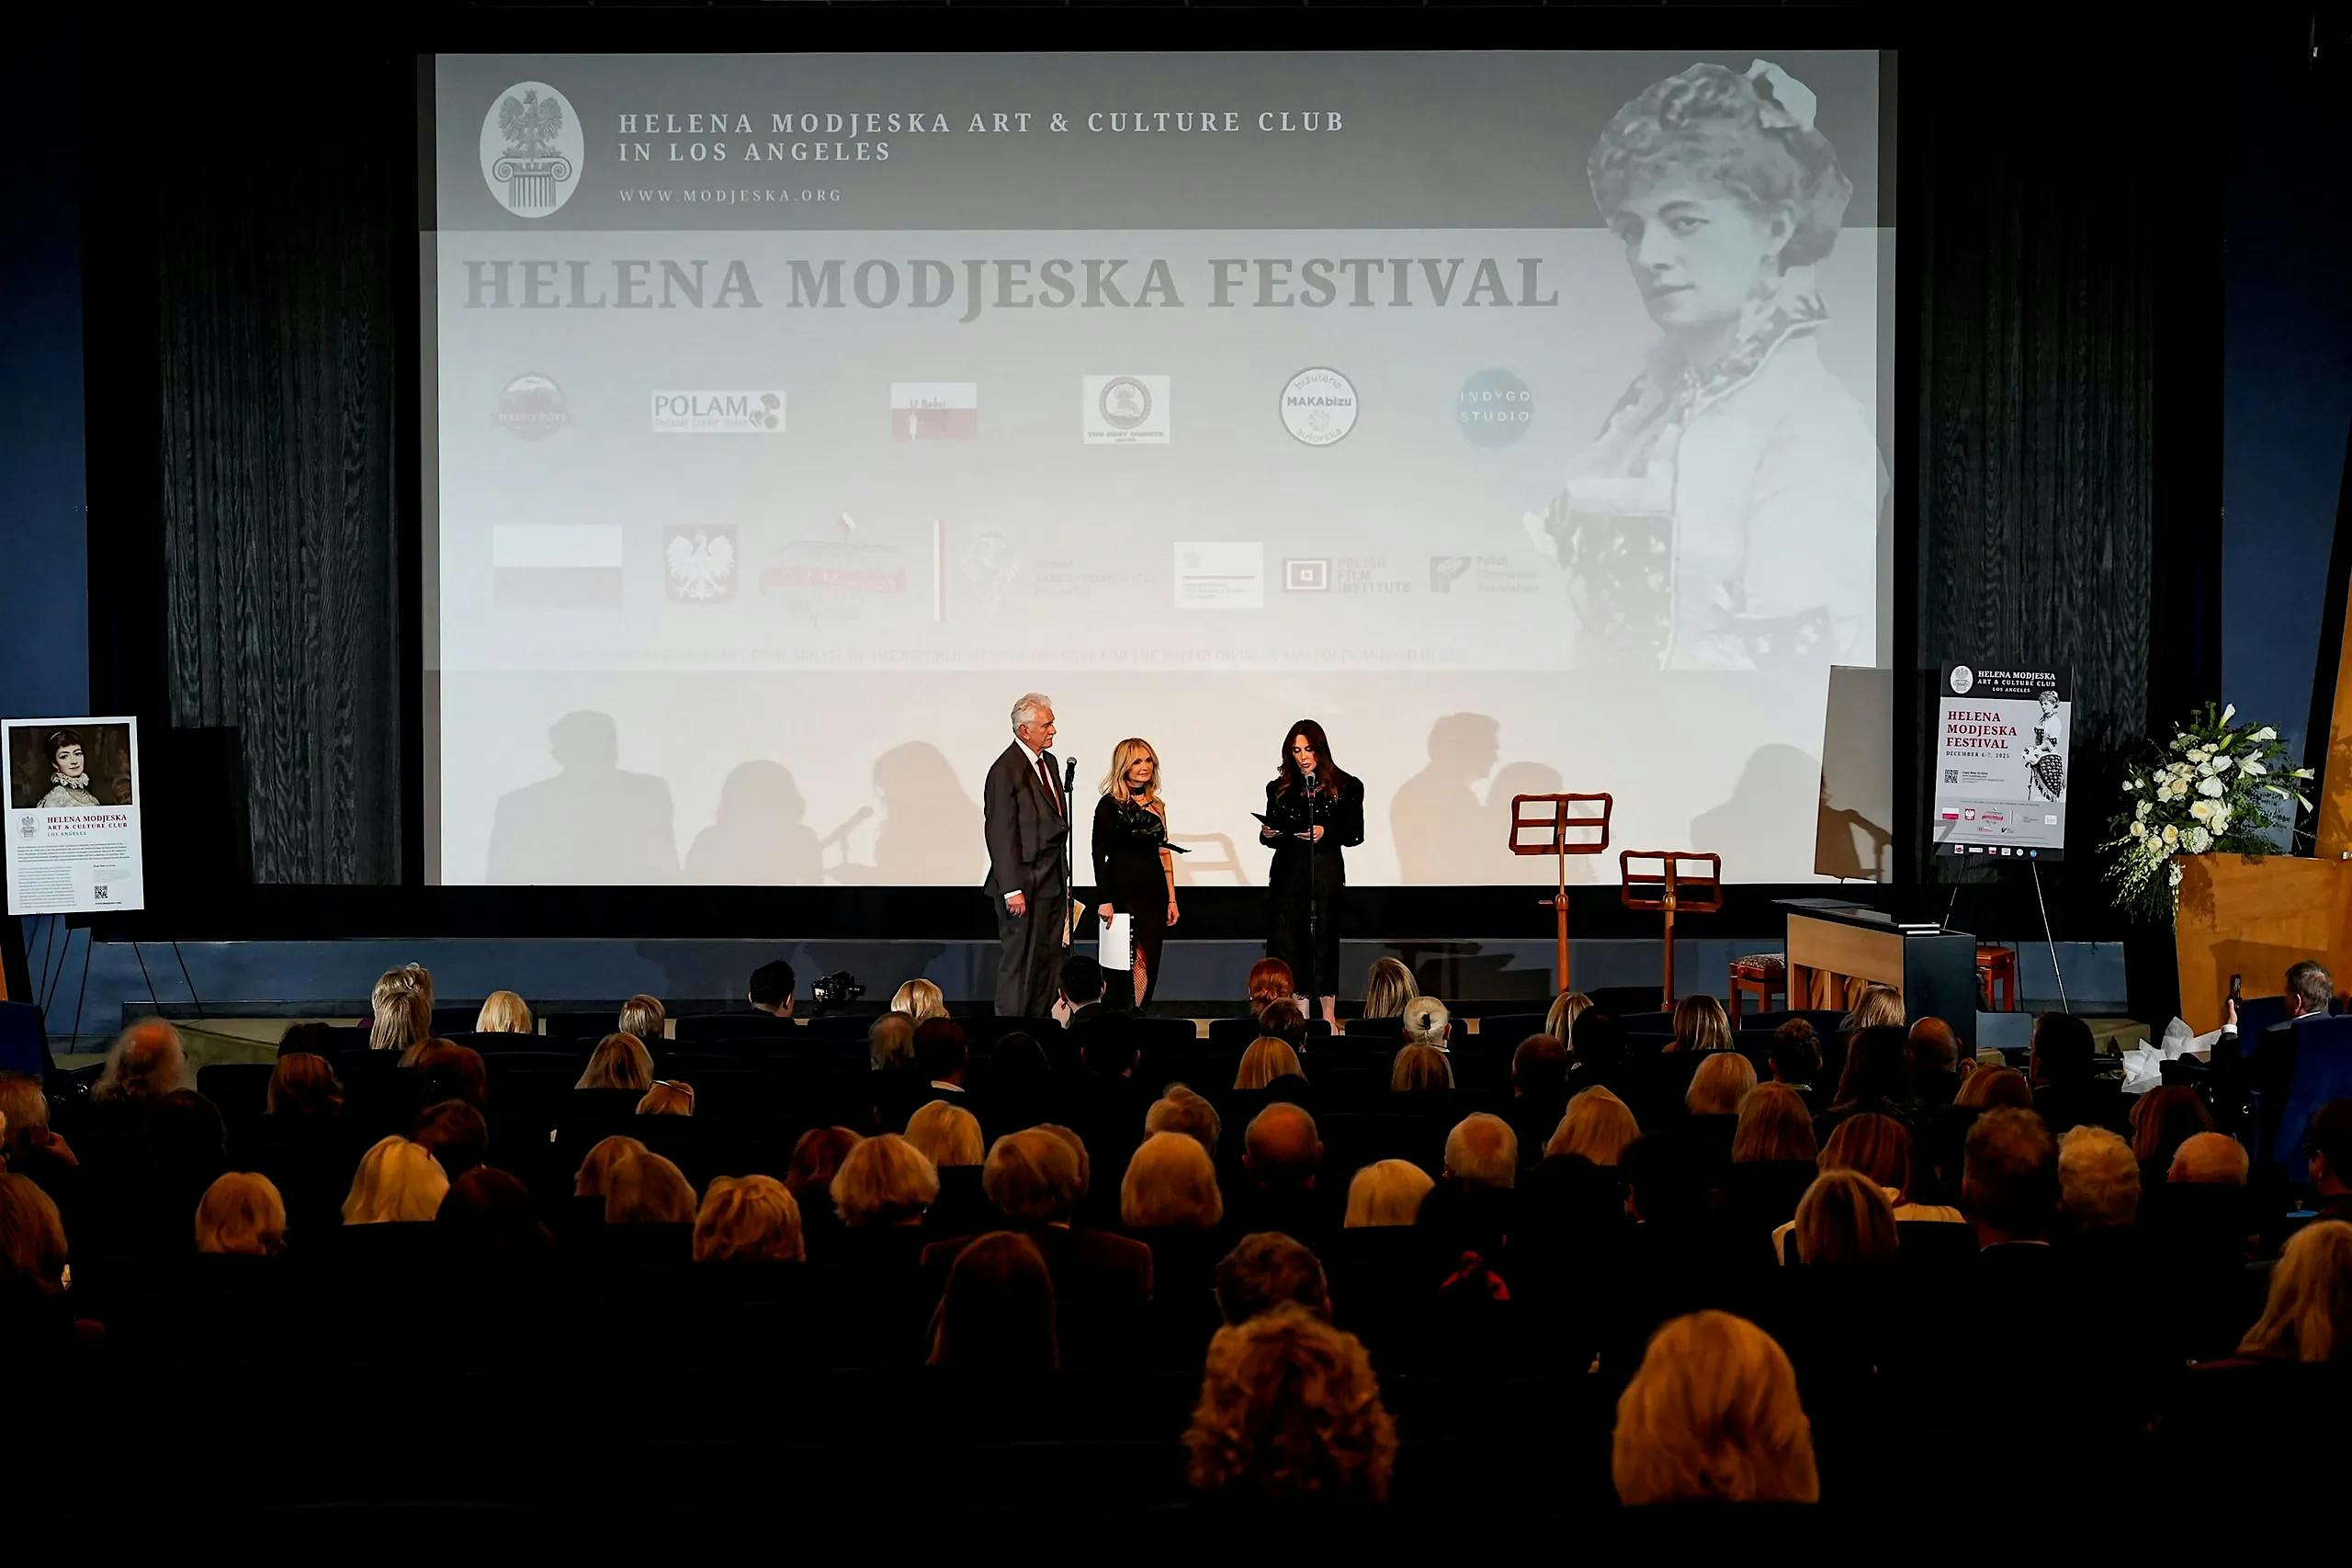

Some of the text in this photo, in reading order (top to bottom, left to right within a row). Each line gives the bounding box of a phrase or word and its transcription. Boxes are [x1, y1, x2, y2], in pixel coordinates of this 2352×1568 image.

[618, 111, 1343, 139] HELENA MODJESKA ART & CULTURE CLUB
[619, 141, 890, 162] IN LOS ANGELES
[619, 189, 842, 206] WWW.MODJESKA.ORG
[461, 256, 1560, 323] HELENA MODJESKA FESTIVAL
[1459, 390, 1531, 403] INDYGO
[654, 395, 748, 417] POLAM
[1460, 411, 1530, 423] STUDIO
[1977, 671, 2056, 681] HELENA MODJESKA
[1947, 711, 2001, 722] HELENA
[1947, 724, 2018, 737] MODJESKA
[1946, 737, 2008, 750] FESTIVAL
[47, 814, 128, 824] HELENA MODJESKA
